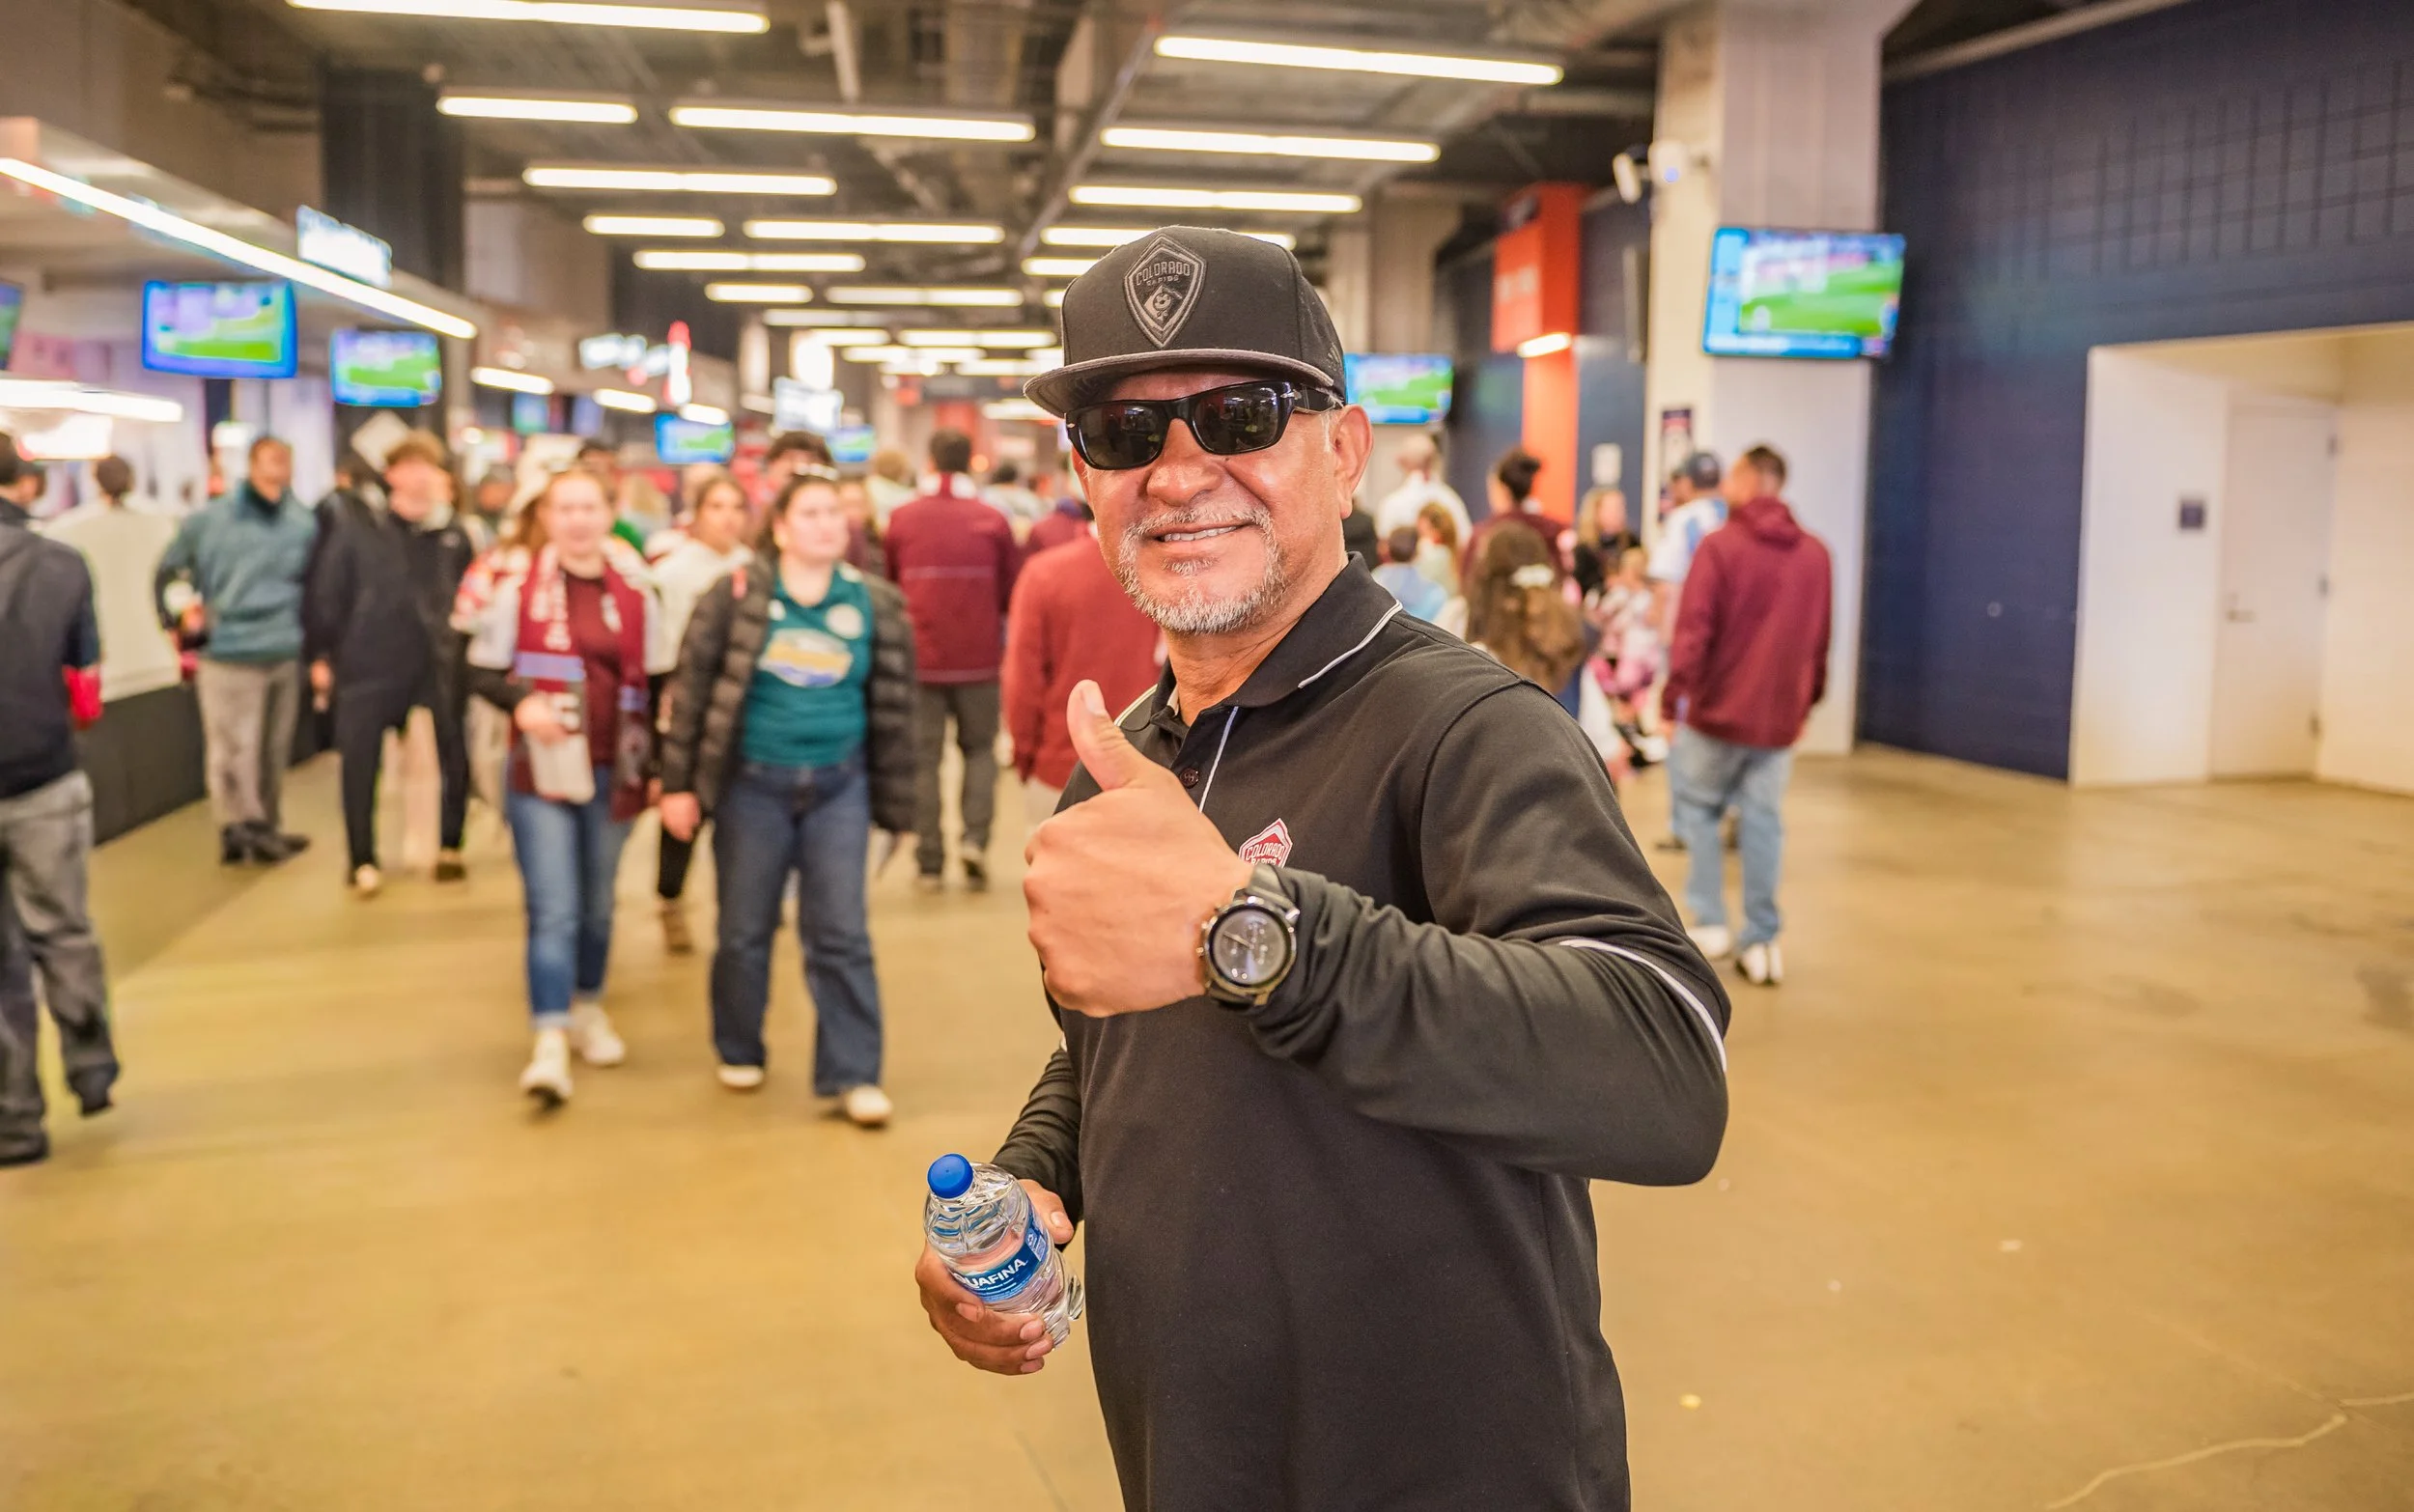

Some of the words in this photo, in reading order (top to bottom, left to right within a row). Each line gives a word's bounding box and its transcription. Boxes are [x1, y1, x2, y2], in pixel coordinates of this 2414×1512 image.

[1136, 261, 1190, 286] COLORADO
[1245, 842, 1284, 861] COLORADO
[952, 1258, 1026, 1289] QUAFINA
